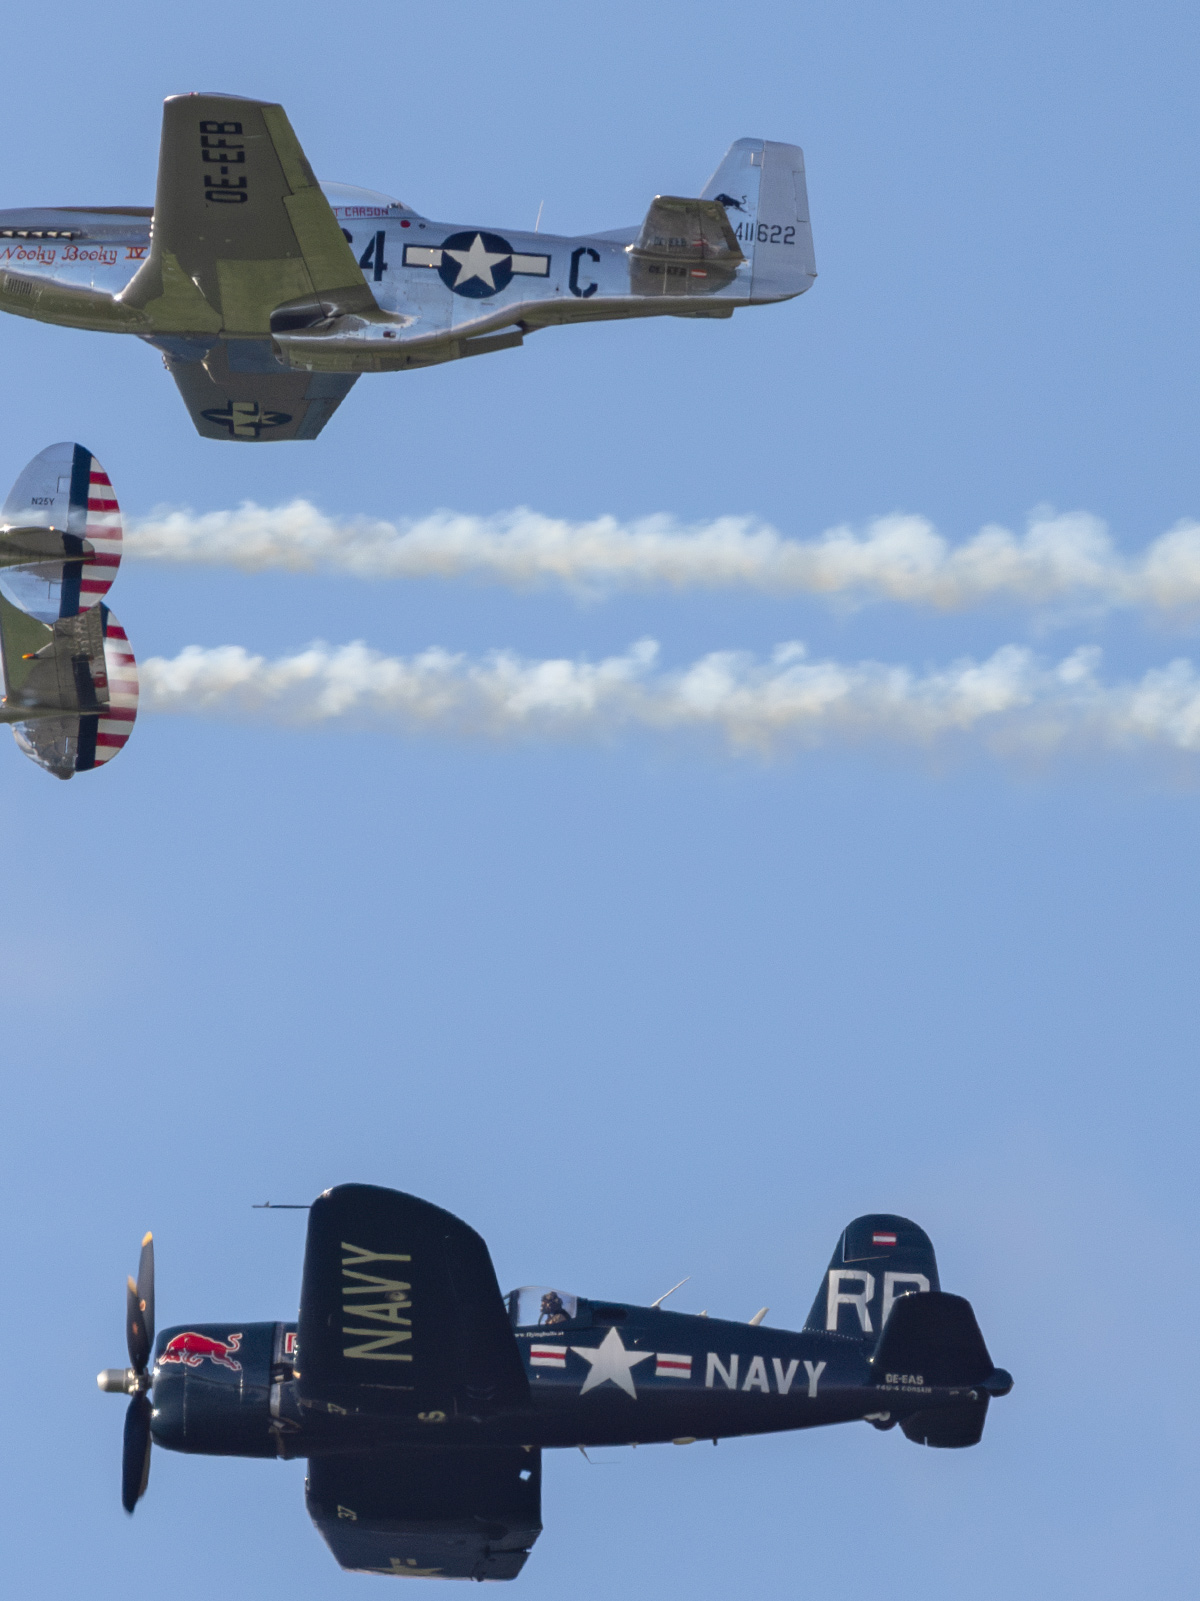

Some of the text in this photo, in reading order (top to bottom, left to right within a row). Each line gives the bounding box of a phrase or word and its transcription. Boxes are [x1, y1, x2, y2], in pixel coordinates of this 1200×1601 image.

[200, 121, 248, 203] OE-EFB
[345, 206, 389, 217] CARSON
[734, 222, 796, 245] 411622
[61, 244, 118, 265] Booky
[125, 246, 148, 260] IV
[341, 228, 600, 298] 4 C
[31, 497, 55, 505] N25Y
[341, 1241, 413, 1361] NAVY
[705, 1352, 827, 1398] NAVY
[885, 1373, 924, 1385] OE-EAS
